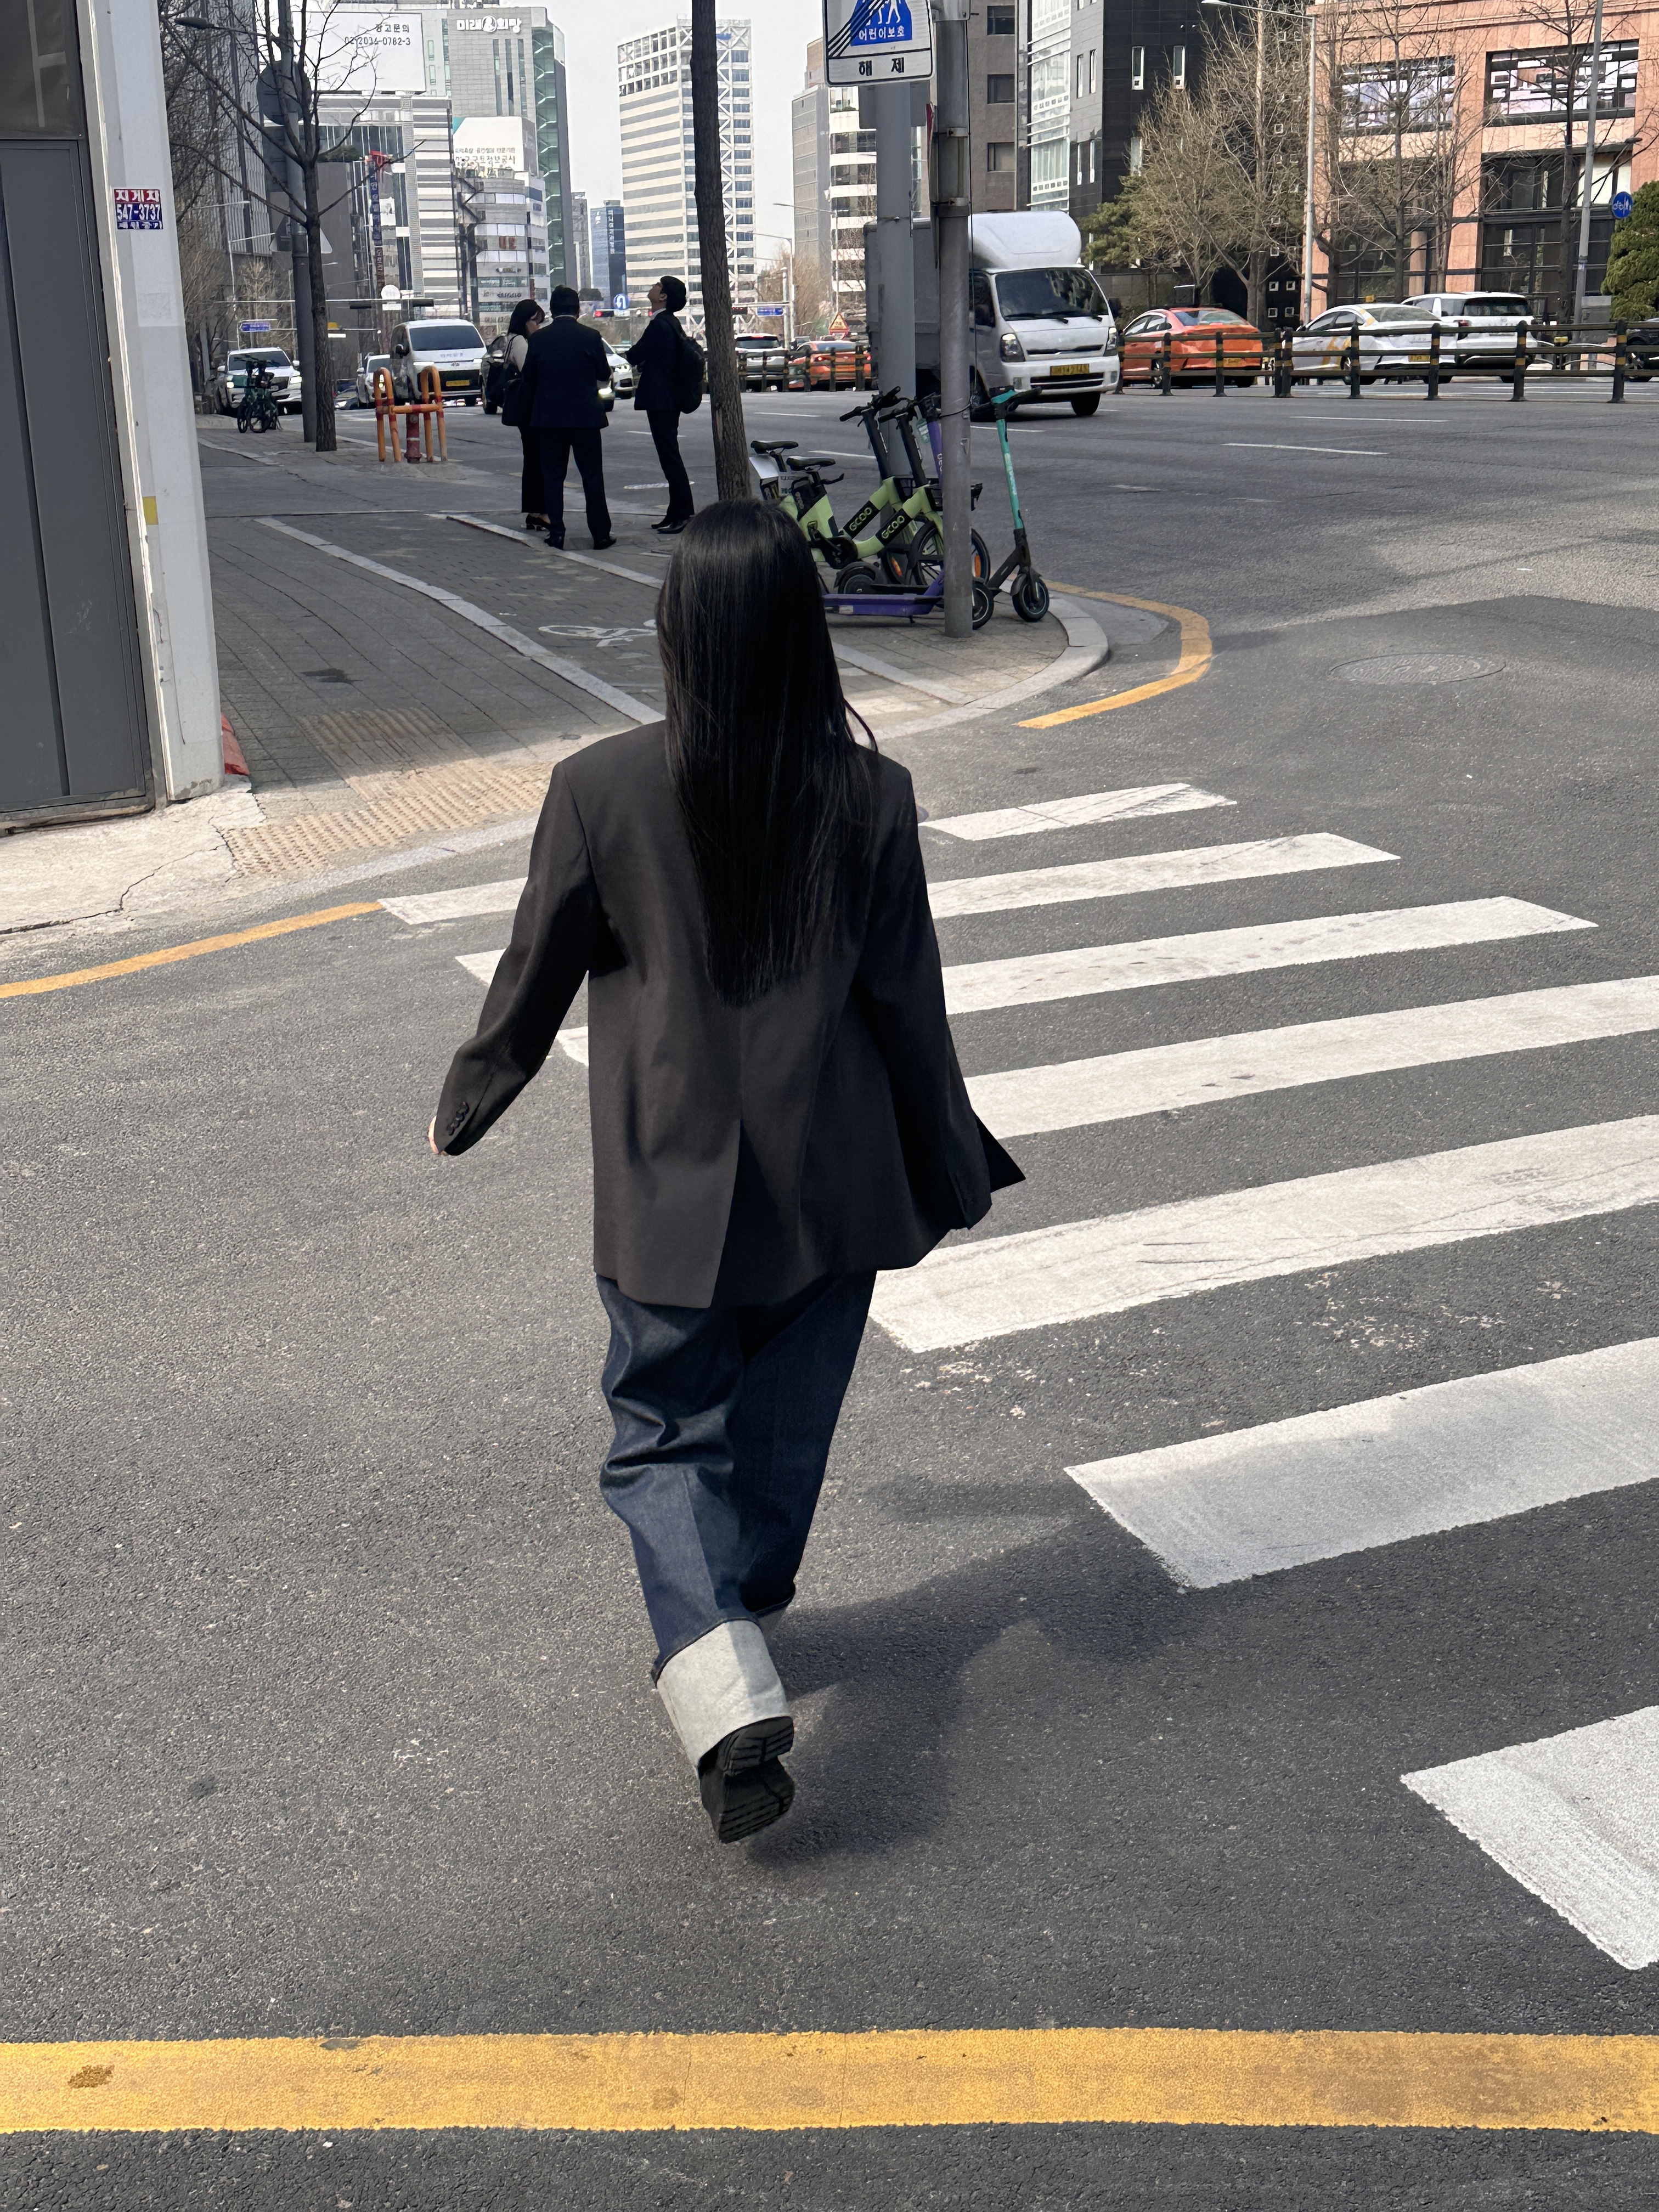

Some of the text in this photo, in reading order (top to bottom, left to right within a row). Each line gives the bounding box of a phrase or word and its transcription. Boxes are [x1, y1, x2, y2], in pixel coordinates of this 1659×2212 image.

[376, 24, 409, 33] 광고문의
[859, 25, 905, 41] 어린이보호
[117, 204, 160, 221] 547-3737
[849, 507, 872, 531] GCOO
[882, 516, 905, 539] GCOO
